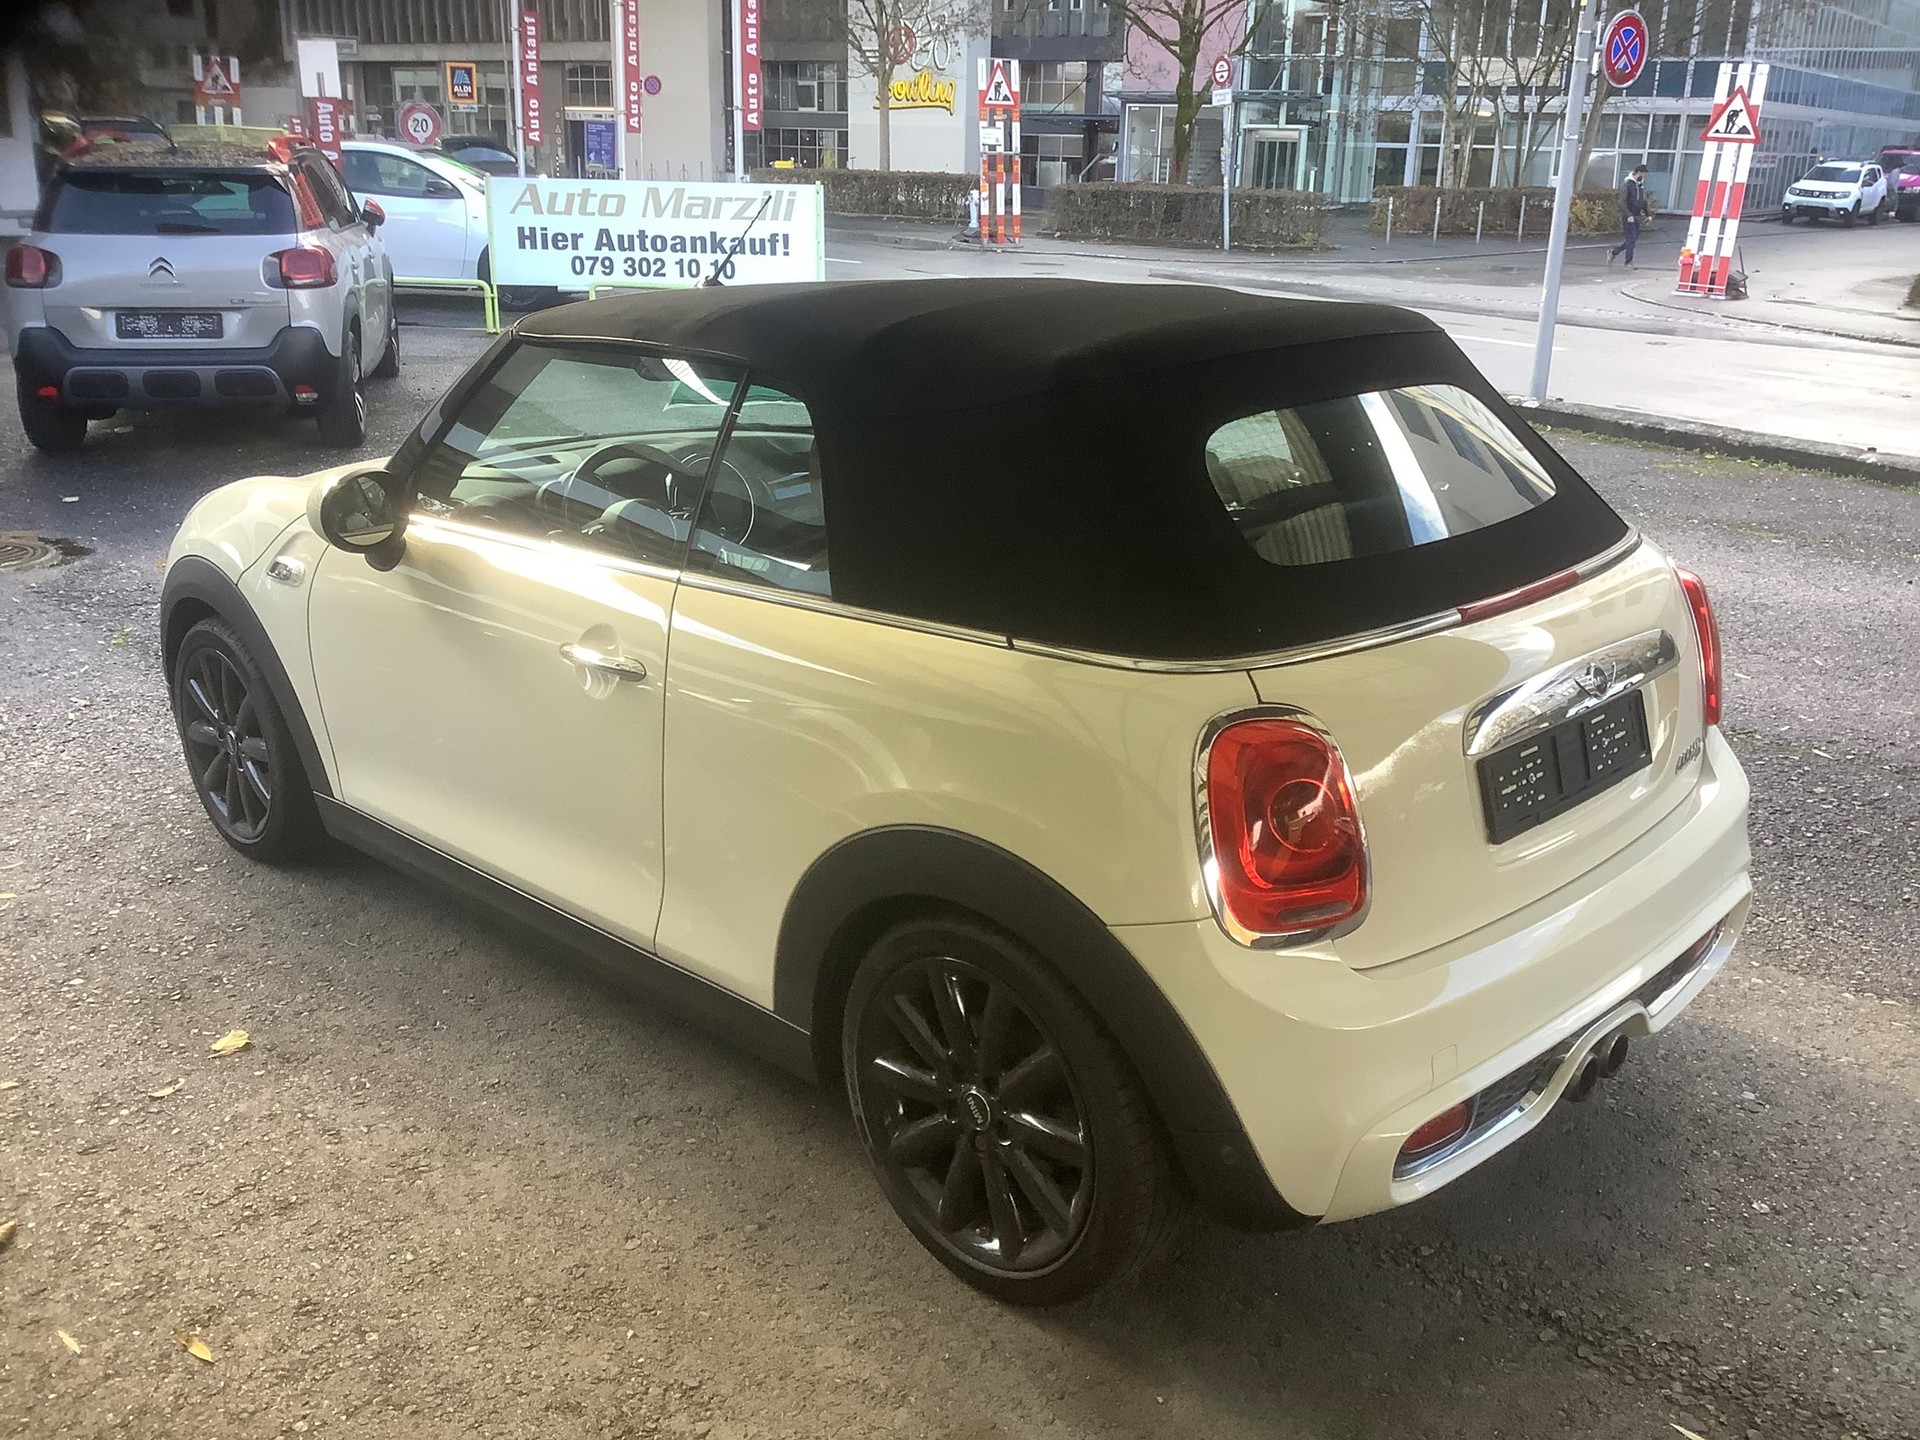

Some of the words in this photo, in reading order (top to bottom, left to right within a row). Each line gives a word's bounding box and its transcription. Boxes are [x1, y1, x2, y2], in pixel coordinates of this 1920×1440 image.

[524, 15, 538, 86] Ankauf
[453, 85, 472, 93] ALDI
[629, 81, 640, 129] Auto
[746, 72, 758, 125] Auto
[316, 101, 335, 143] Auto
[412, 118, 428, 133] 20
[528, 98, 540, 142] Auto
[509, 183, 626, 217] Auto
[641, 187, 797, 221] Marzili
[517, 226, 584, 251] Hier
[594, 228, 790, 257] Autoankauf!
[571, 255, 614, 277] 079
[623, 256, 666, 278] 302
[675, 257, 701, 278] 10
[710, 258, 736, 280] 10
[966, 1096, 984, 1125] MINI
